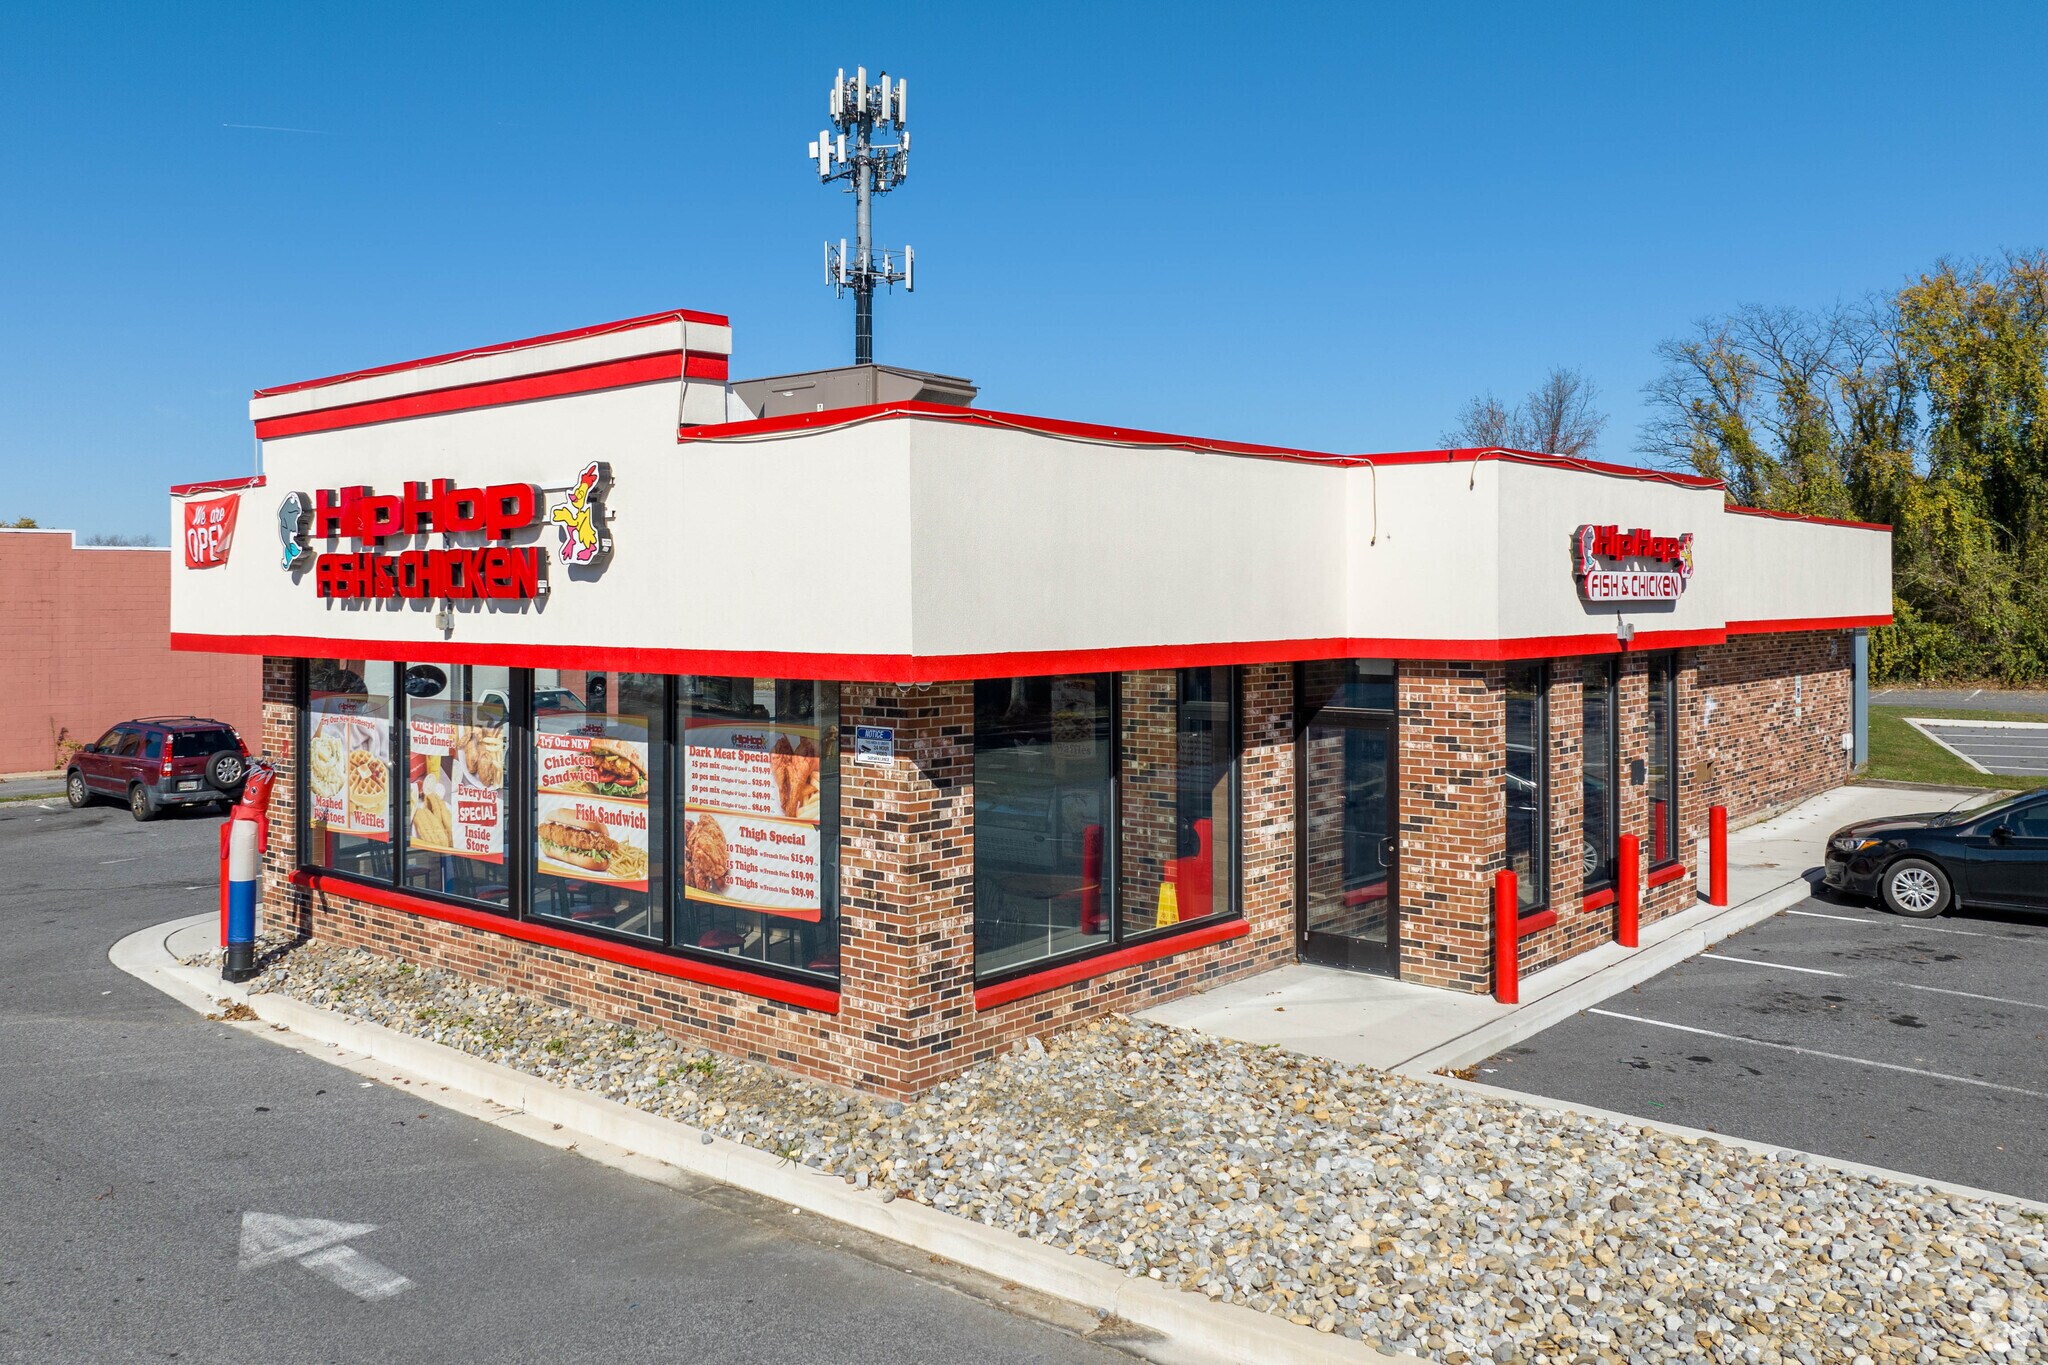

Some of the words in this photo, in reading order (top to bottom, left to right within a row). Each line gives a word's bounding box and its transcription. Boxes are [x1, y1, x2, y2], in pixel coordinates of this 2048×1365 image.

[192, 505, 206, 525] We
[210, 507, 225, 524] are
[316, 552, 374, 598] FISH
[374, 556, 395, 598] &
[1591, 574, 1619, 597] FISH
[1621, 576, 1629, 596] &
[434, 722, 456, 735] Drink
[865, 729, 884, 738] NOTICE
[413, 735, 429, 745] with
[430, 736, 456, 748] dinner!
[539, 735, 553, 750] Try
[554, 736, 570, 749] Our
[571, 737, 590, 750] NEW
[1056, 742, 1092, 756] Waffles
[544, 753, 594, 770] Chicken
[689, 745, 711, 758] Dark
[713, 746, 737, 760] Meat
[738, 749, 772, 764] Special
[541, 768, 599, 787] Sandwich
[752, 766, 771, 775] $19.99
[458, 783, 498, 803] Everyday
[315, 796, 343, 809] Mashed
[699, 798, 708, 806] pcs
[709, 798, 720, 806] mix
[314, 808, 345, 824] Potatoes
[354, 810, 385, 829] Waffles
[459, 804, 497, 821] SPECIAL
[575, 803, 596, 822] Fish
[598, 806, 647, 830] Sandwich
[465, 826, 491, 841] Inside
[739, 826, 767, 842] Thigh
[769, 830, 806, 846] Special
[466, 838, 490, 853] Store
[726, 844, 733, 852] 10
[735, 844, 758, 857] Thighs
[791, 853, 814, 865] $15.99
[726, 860, 733, 868] 15
[735, 860, 758, 874] Thighs
[791, 870, 814, 882] $19.99
[726, 876, 733, 884] 20
[735, 876, 758, 890] Thighs
[791, 887, 814, 899] $29.99
